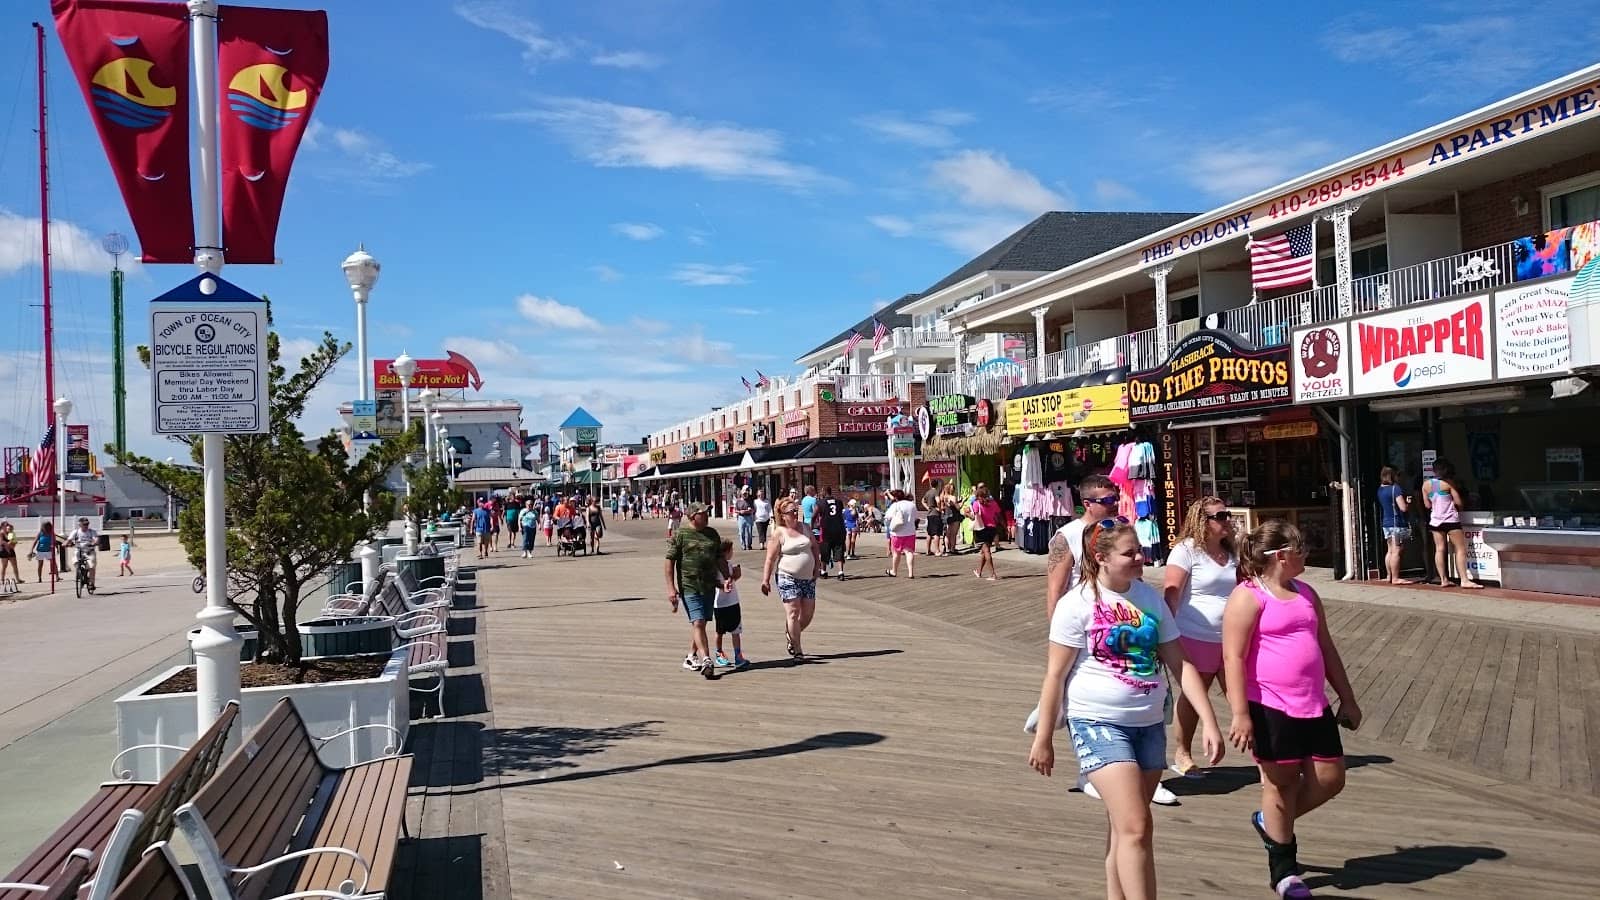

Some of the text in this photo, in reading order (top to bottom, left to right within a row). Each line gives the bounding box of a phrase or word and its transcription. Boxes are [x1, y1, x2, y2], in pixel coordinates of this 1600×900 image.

[1429, 84, 1600, 165] APARTME
[1268, 158, 1406, 219] 410-289-5544
[1142, 212, 1252, 263] THE COLONY
[1519, 288, 1542, 300] Great
[1524, 303, 1534, 311] be
[159, 313, 252, 339] TOWN OF OCEAN CITY
[1408, 317, 1424, 325] THE
[1516, 315, 1538, 324] What
[1512, 329, 1534, 337] Wrap
[1546, 323, 1567, 331] Bake
[1358, 301, 1484, 375] WRAPPER
[1534, 334, 1567, 346] Deliciou
[155, 343, 256, 355] BICYCLE REGULATIONS
[1502, 349, 1517, 358] Soft
[1520, 350, 1547, 359] Pretzel
[1171, 343, 1214, 372] FLASHBACK
[1502, 356, 1568, 372] Always Open La
[1414, 361, 1446, 379] pepsi
[379, 375, 416, 384] Belie
[419, 375, 428, 384] It
[443, 375, 466, 384] Not!
[1130, 379, 1161, 403] OLD
[1163, 364, 1205, 401] TIME
[1208, 357, 1289, 385] PHOTOS
[1302, 378, 1342, 390] YOUR
[1197, 395, 1226, 407] PORTRAITS
[1230, 391, 1249, 403] READY
[1251, 390, 1258, 400] IN
[1260, 386, 1289, 399] MINUTES
[1300, 388, 1343, 399] PRETZEL?
[848, 406, 903, 416] CANDY
[1022, 398, 1039, 415] LAST
[1042, 394, 1062, 413] STOP
[1029, 417, 1056, 429] BEACHWEAR
[1163, 434, 1176, 550] OLD TIME PHOTOS
[829, 504, 836, 515] 3
